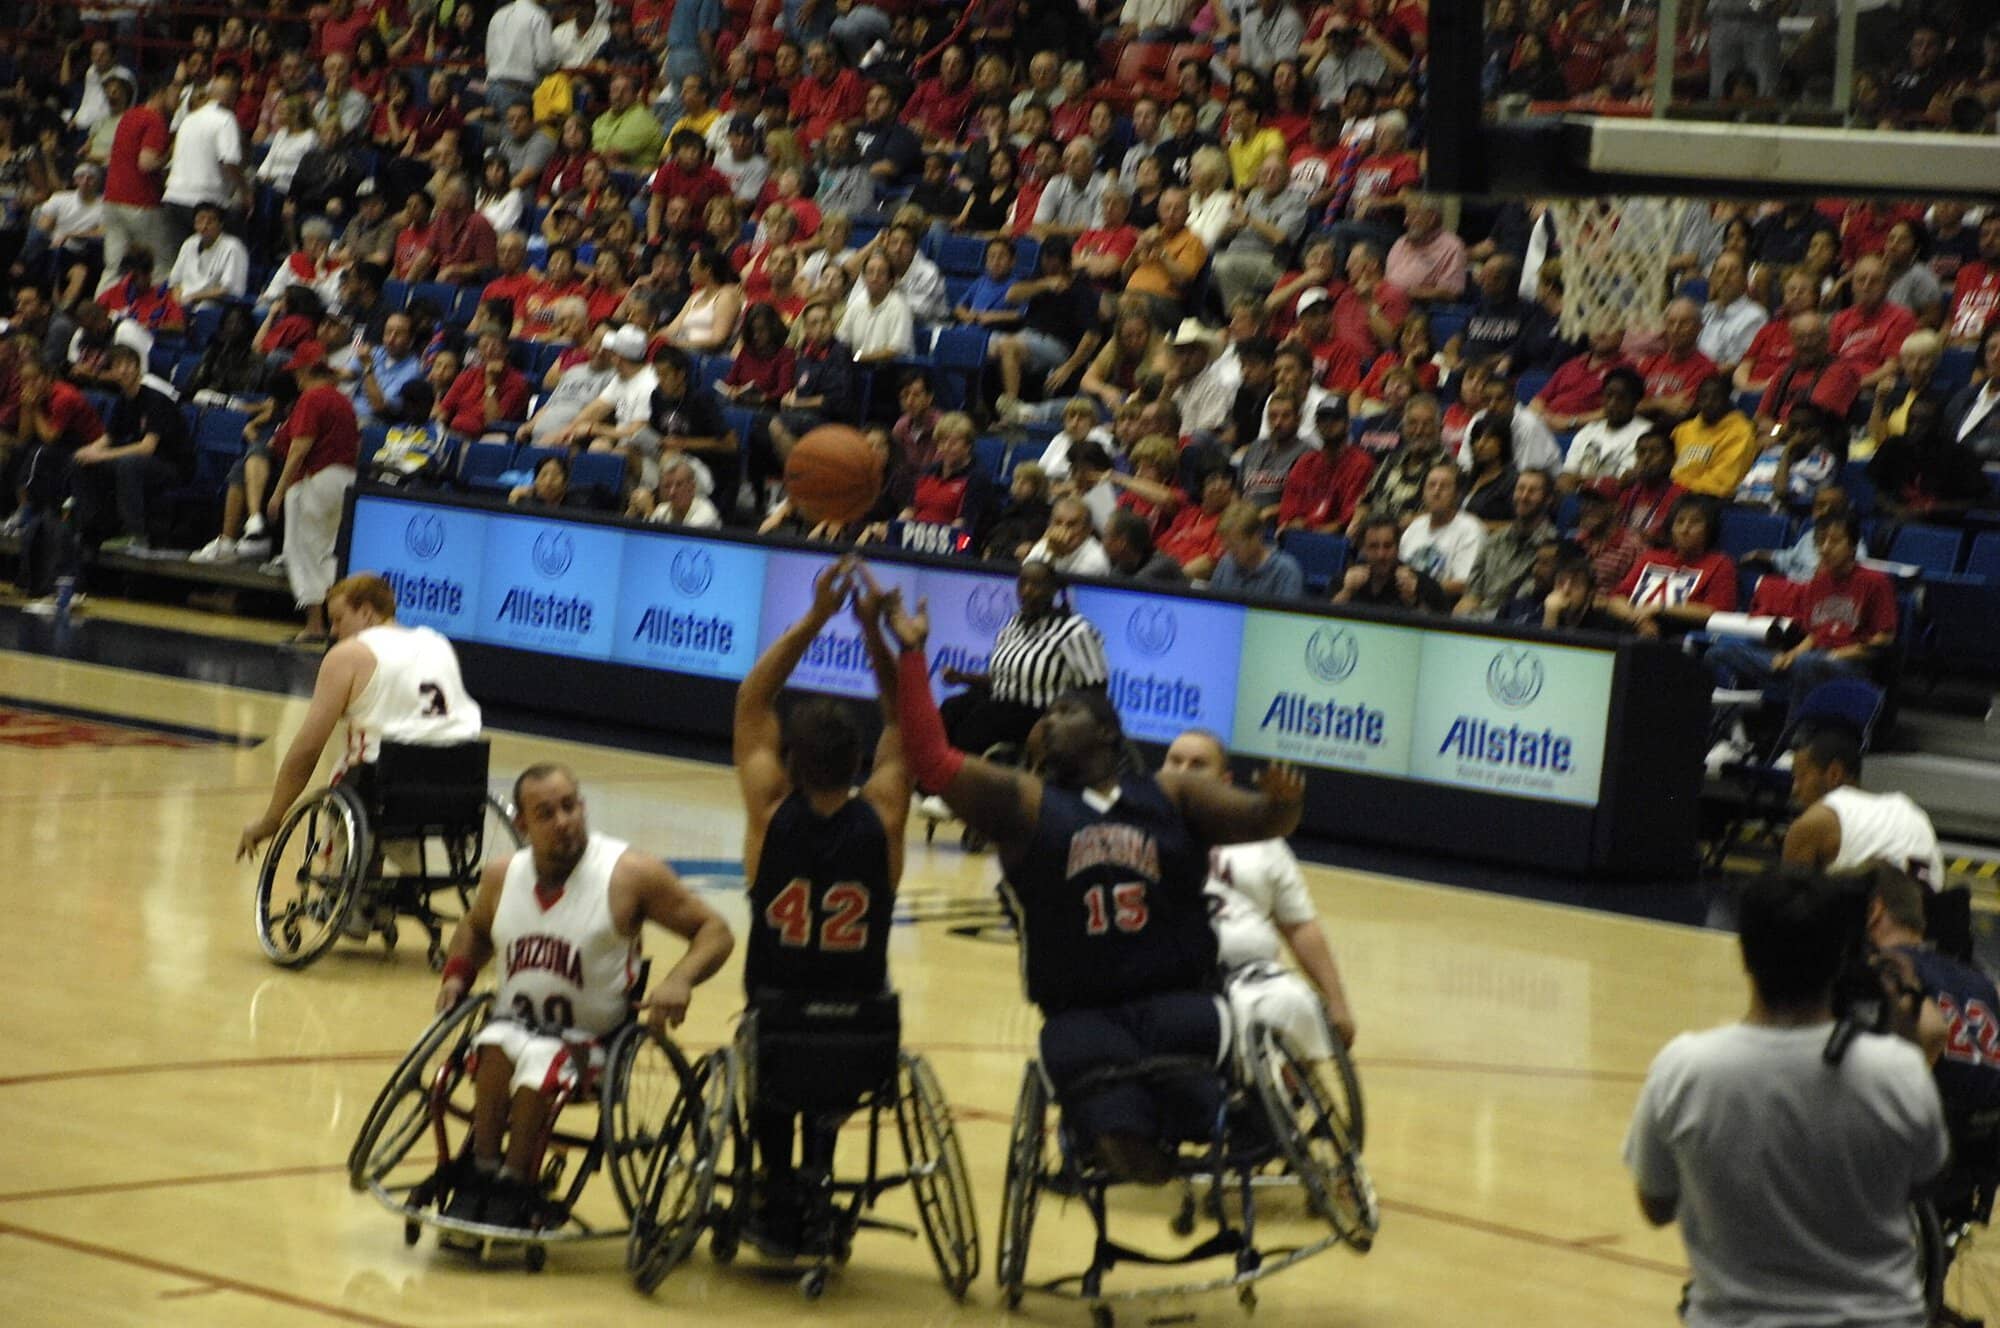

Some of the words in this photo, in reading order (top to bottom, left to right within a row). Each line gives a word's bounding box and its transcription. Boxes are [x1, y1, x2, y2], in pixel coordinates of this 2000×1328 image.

[496, 588, 593, 634] Allstate
[633, 607, 734, 654] Allstate
[1108, 668, 1202, 722] llstate
[1260, 690, 1386, 746] Allstate
[1438, 715, 1576, 773] Allstate
[765, 878, 870, 952] 42
[1083, 881, 1149, 936] 15
